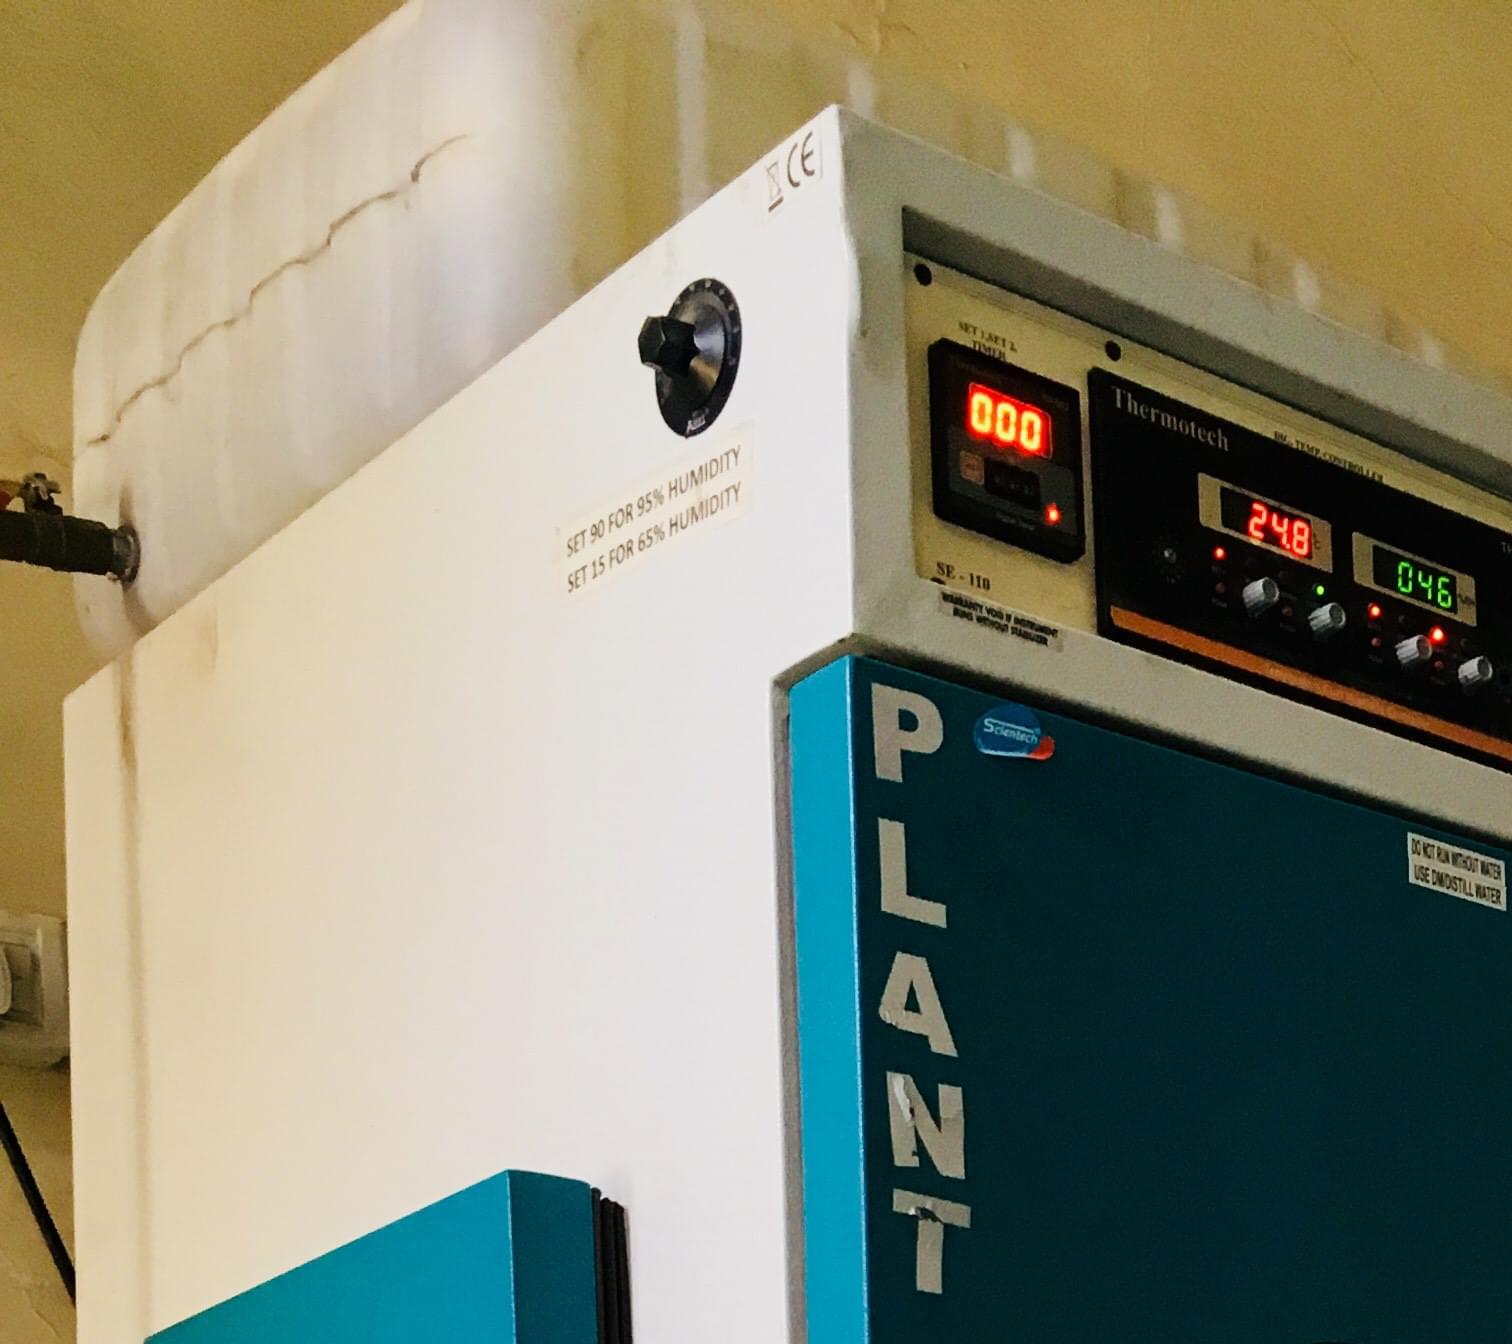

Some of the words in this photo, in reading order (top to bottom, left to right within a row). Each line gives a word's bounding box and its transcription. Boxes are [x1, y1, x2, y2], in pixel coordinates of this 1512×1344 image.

[969, 391, 1043, 453] 000
[1111, 384, 1230, 452] Thermotech
[566, 528, 589, 558] SET
[589, 519, 606, 545] 90
[607, 502, 634, 535] FOR
[635, 484, 666, 518] 95%
[667, 443, 742, 501] HUMIDITY
[567, 563, 589, 594] SET
[591, 555, 606, 581] 15
[608, 537, 635, 570] FOR
[636, 521, 667, 553] 65%
[667, 480, 742, 538] HUMIDITY
[1248, 501, 1312, 557] 24.8
[969, 572, 991, 591] 110
[1397, 561, 1452, 609] 046
[983, 717, 1038, 745] Scientech
[1411, 837, 1421, 857] DO
[1480, 858, 1502, 881] WATER
[1414, 864, 1431, 884] USE
[1475, 884, 1502, 905] WATER
[871, 682, 973, 1296] PLANT
